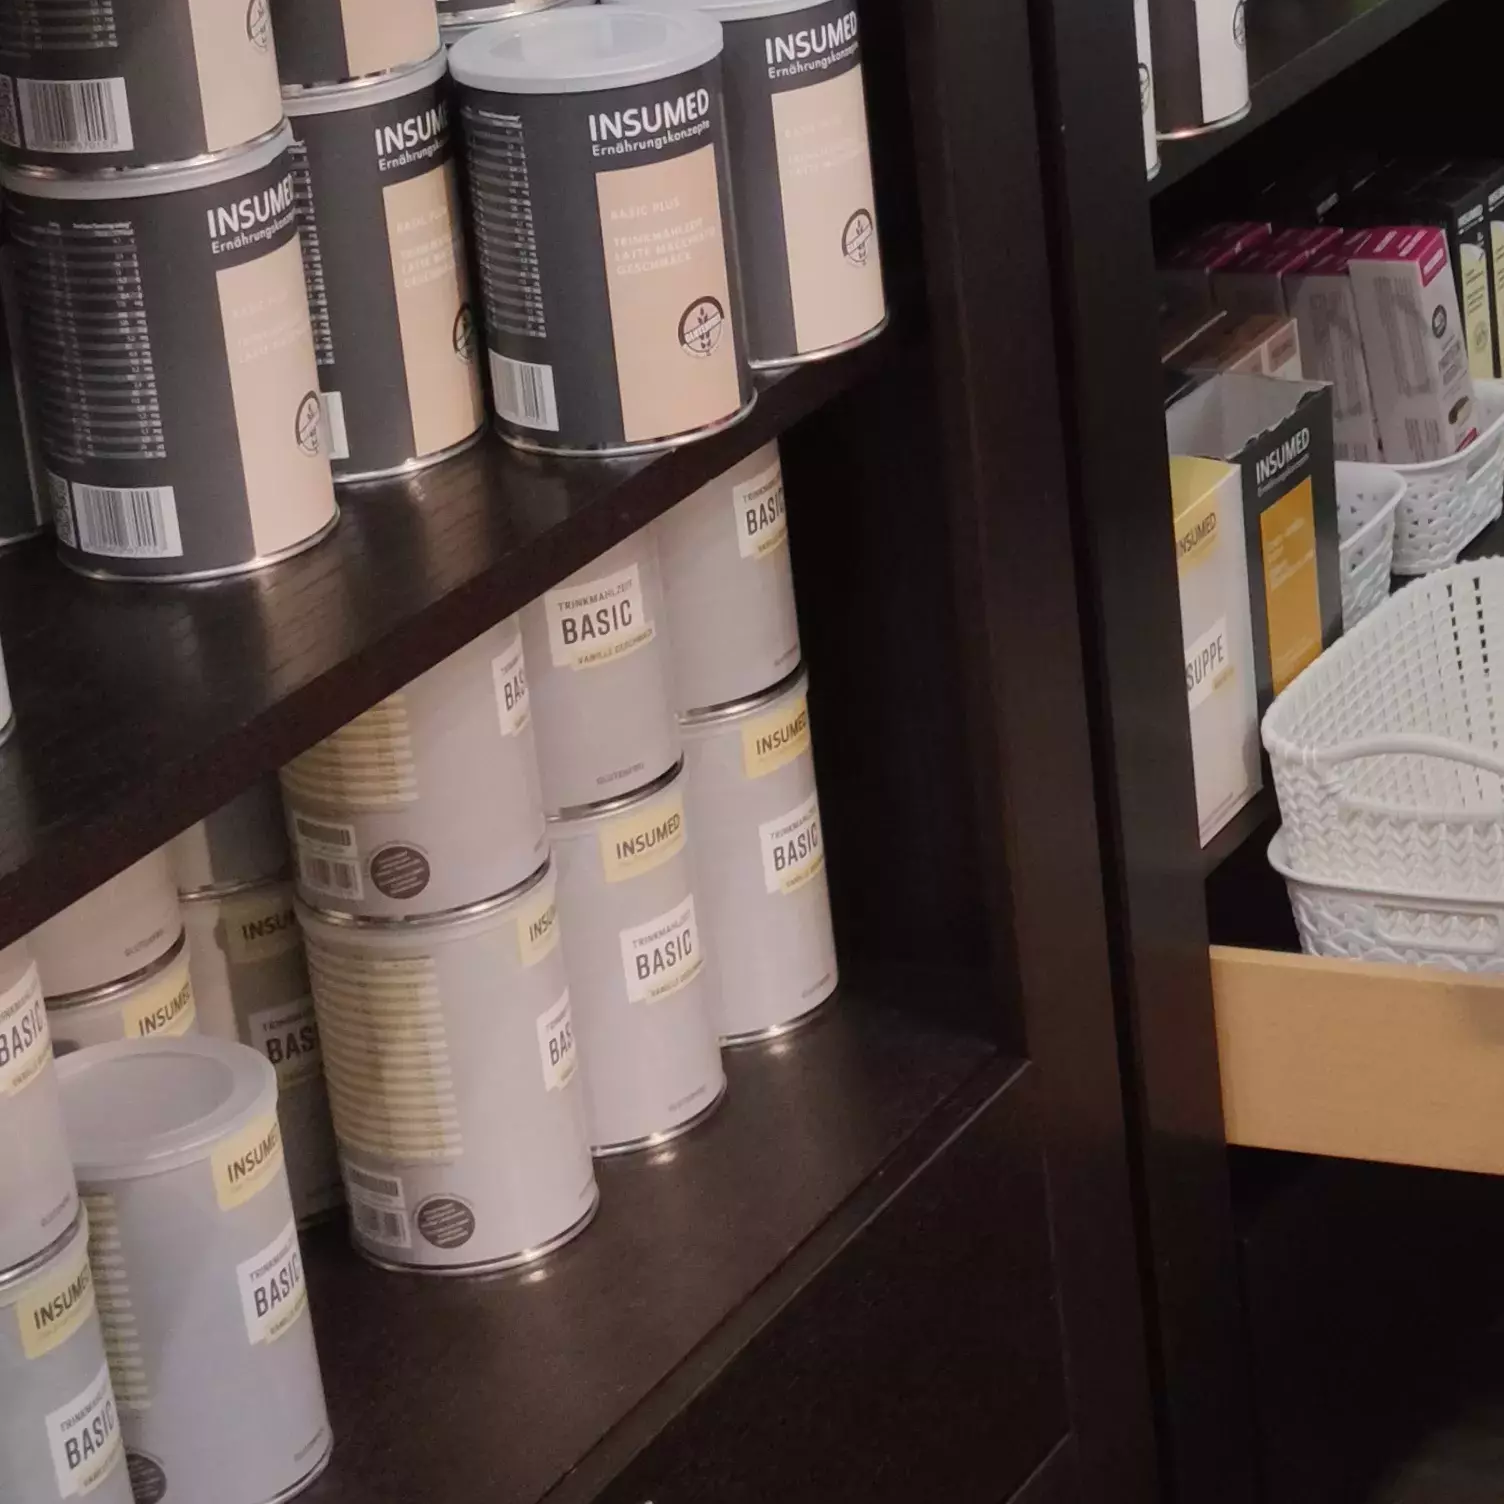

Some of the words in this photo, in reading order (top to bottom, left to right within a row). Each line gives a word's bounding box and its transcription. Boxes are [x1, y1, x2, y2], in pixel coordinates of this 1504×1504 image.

[764, 10, 858, 65] INSUMED
[588, 88, 710, 142] INSUMED
[592, 119, 711, 158] Ernährungskonzepte
[609, 203, 648, 222] BASIC
[652, 197, 681, 215] PLUS
[614, 246, 650, 263] LATTE
[1256, 427, 1310, 486] INSUMED
[558, 578, 633, 612] TRINKMAHLZEIT
[561, 599, 633, 645] BASIC
[1186, 634, 1224, 693] SUPPE
[756, 711, 807, 755] INSUMED
[615, 813, 681, 860] INSUMED
[774, 820, 819, 871] BASIC
[635, 929, 693, 980] BASIC
[253, 1250, 303, 1319] BASIC
[64, 1401, 115, 1470] BASIC
